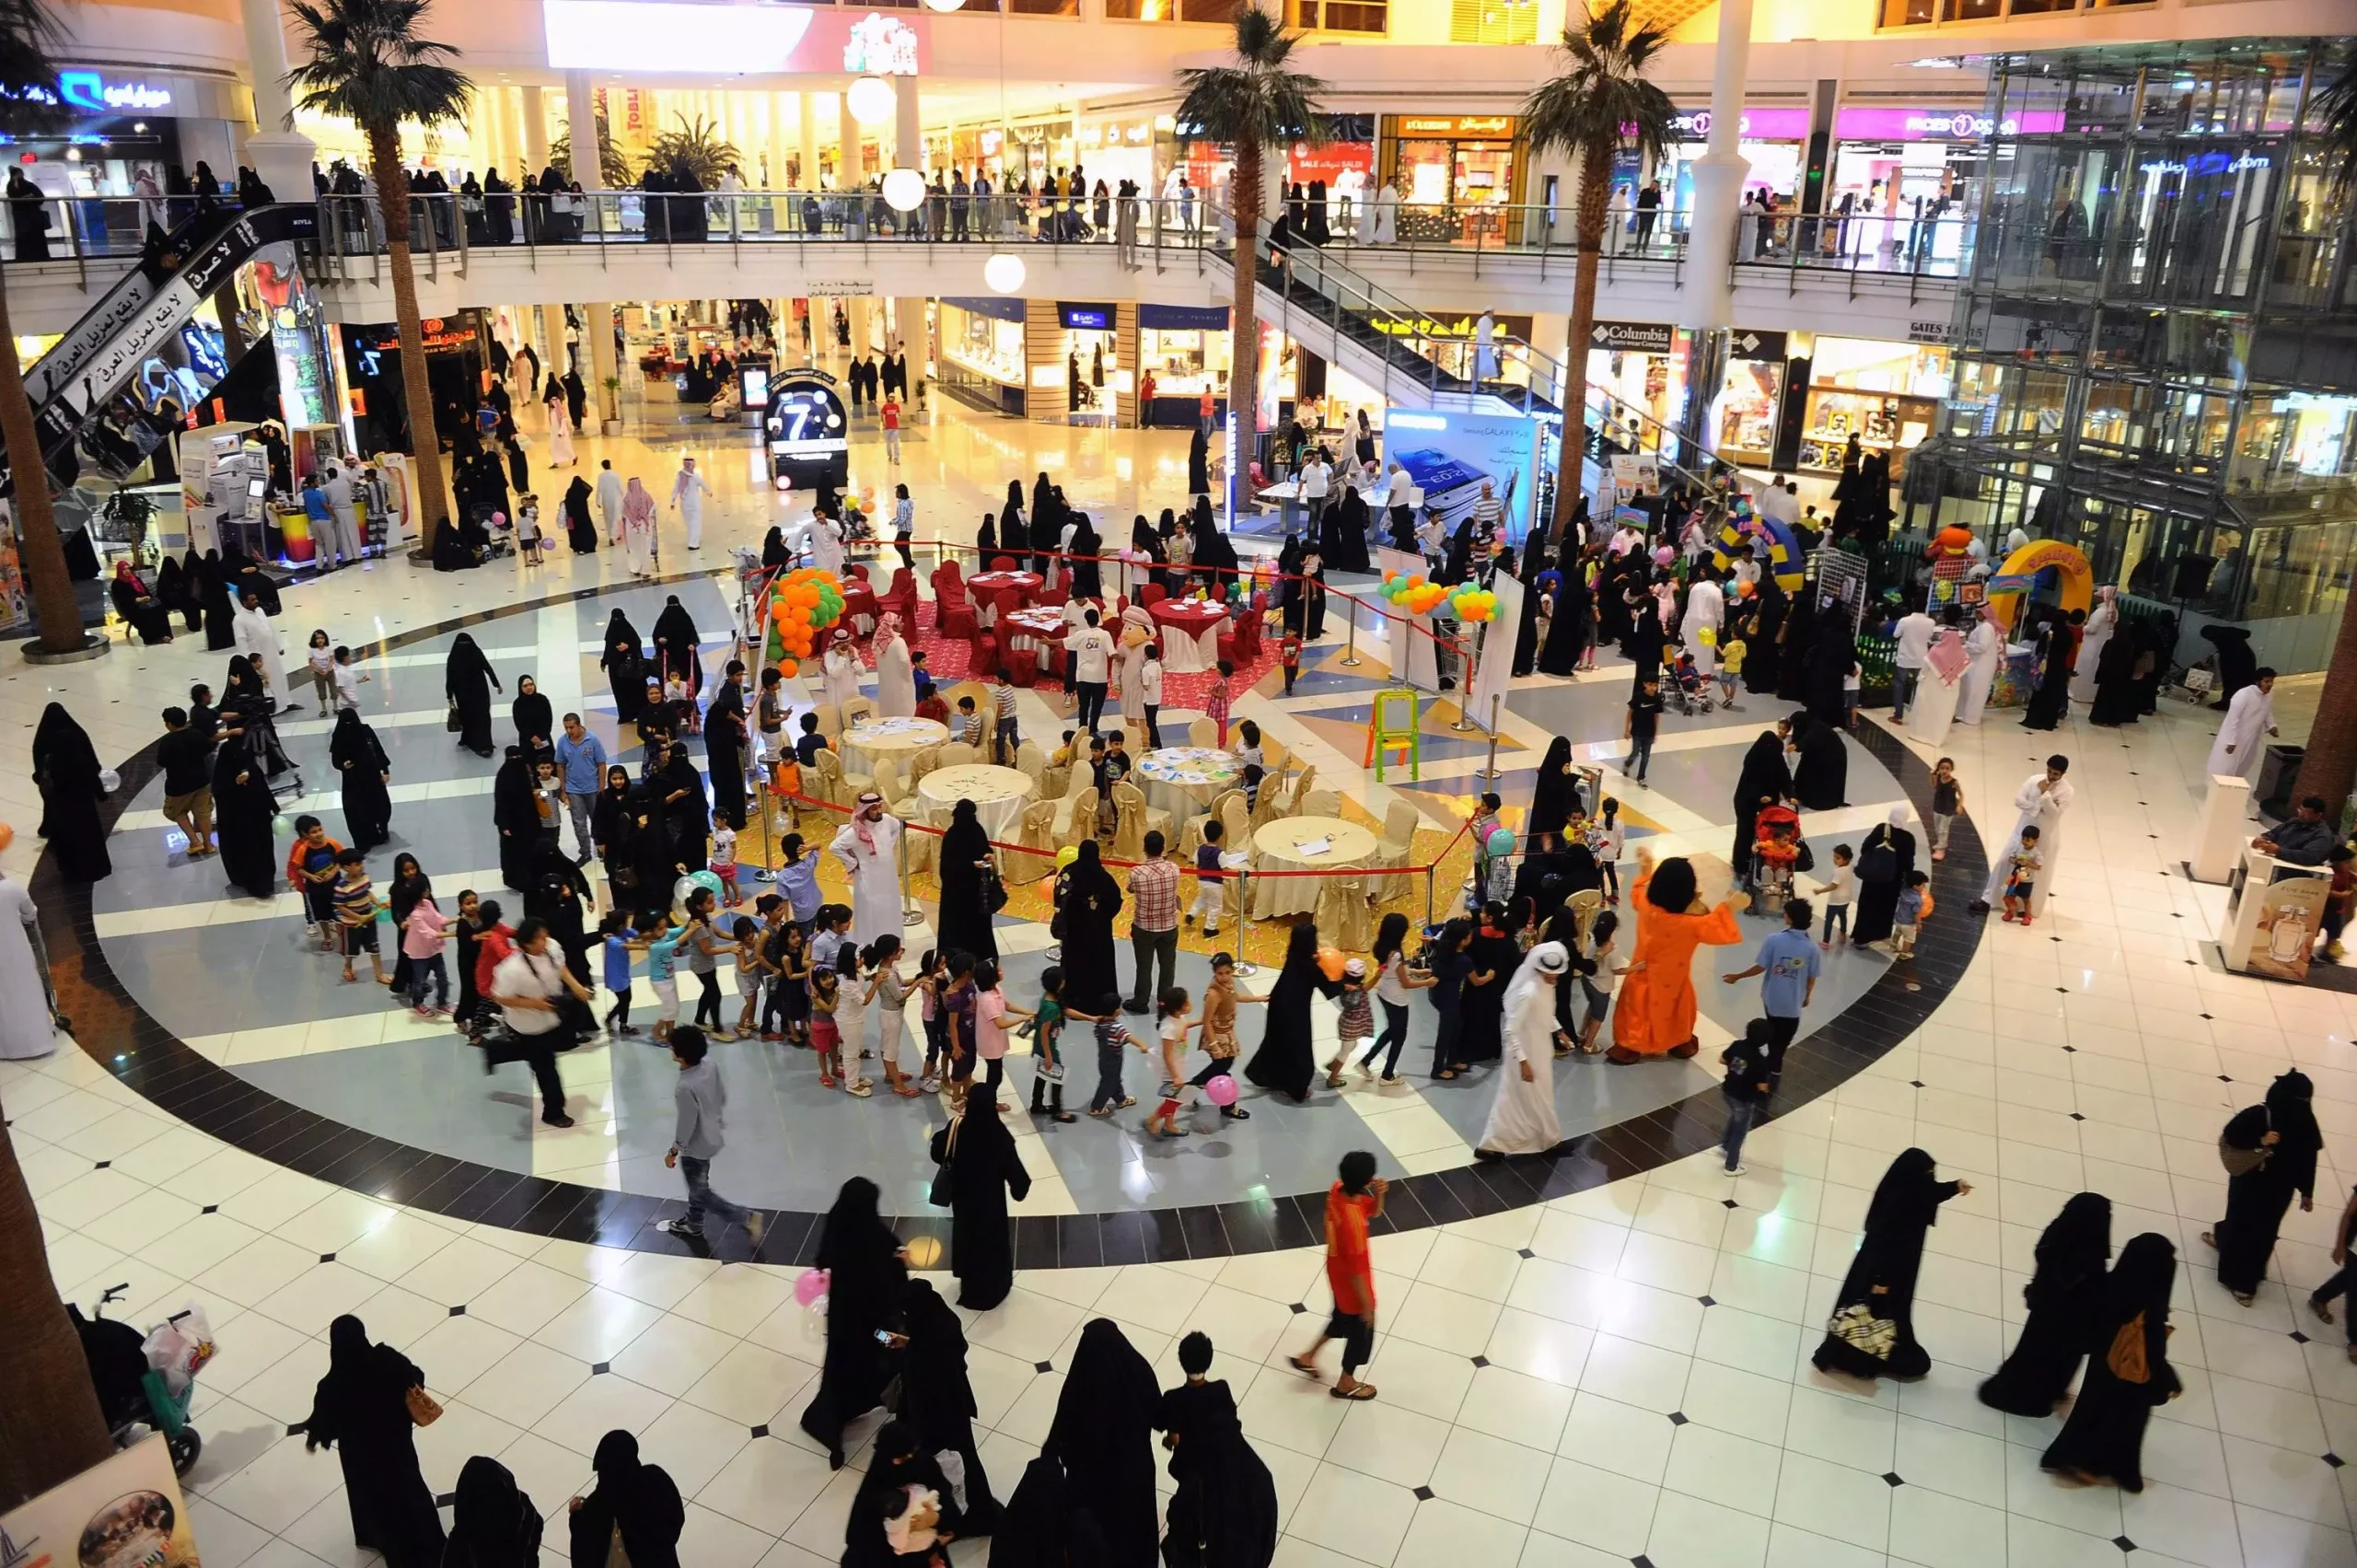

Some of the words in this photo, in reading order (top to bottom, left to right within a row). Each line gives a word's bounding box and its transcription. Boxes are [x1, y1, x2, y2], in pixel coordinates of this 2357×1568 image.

[217, 241, 231, 256] لا
[188, 256, 221, 289] عرق
[129, 287, 142, 301] لا
[168, 293, 181, 306] لا
[1608, 325, 1668, 342] Columbia
[1910, 322, 1942, 333] GATES
[127, 319, 156, 355] لمزيل
[56, 342, 87, 376] العرق
[97, 349, 127, 382] العرق
[1484, 427, 1514, 436] GALAXY
